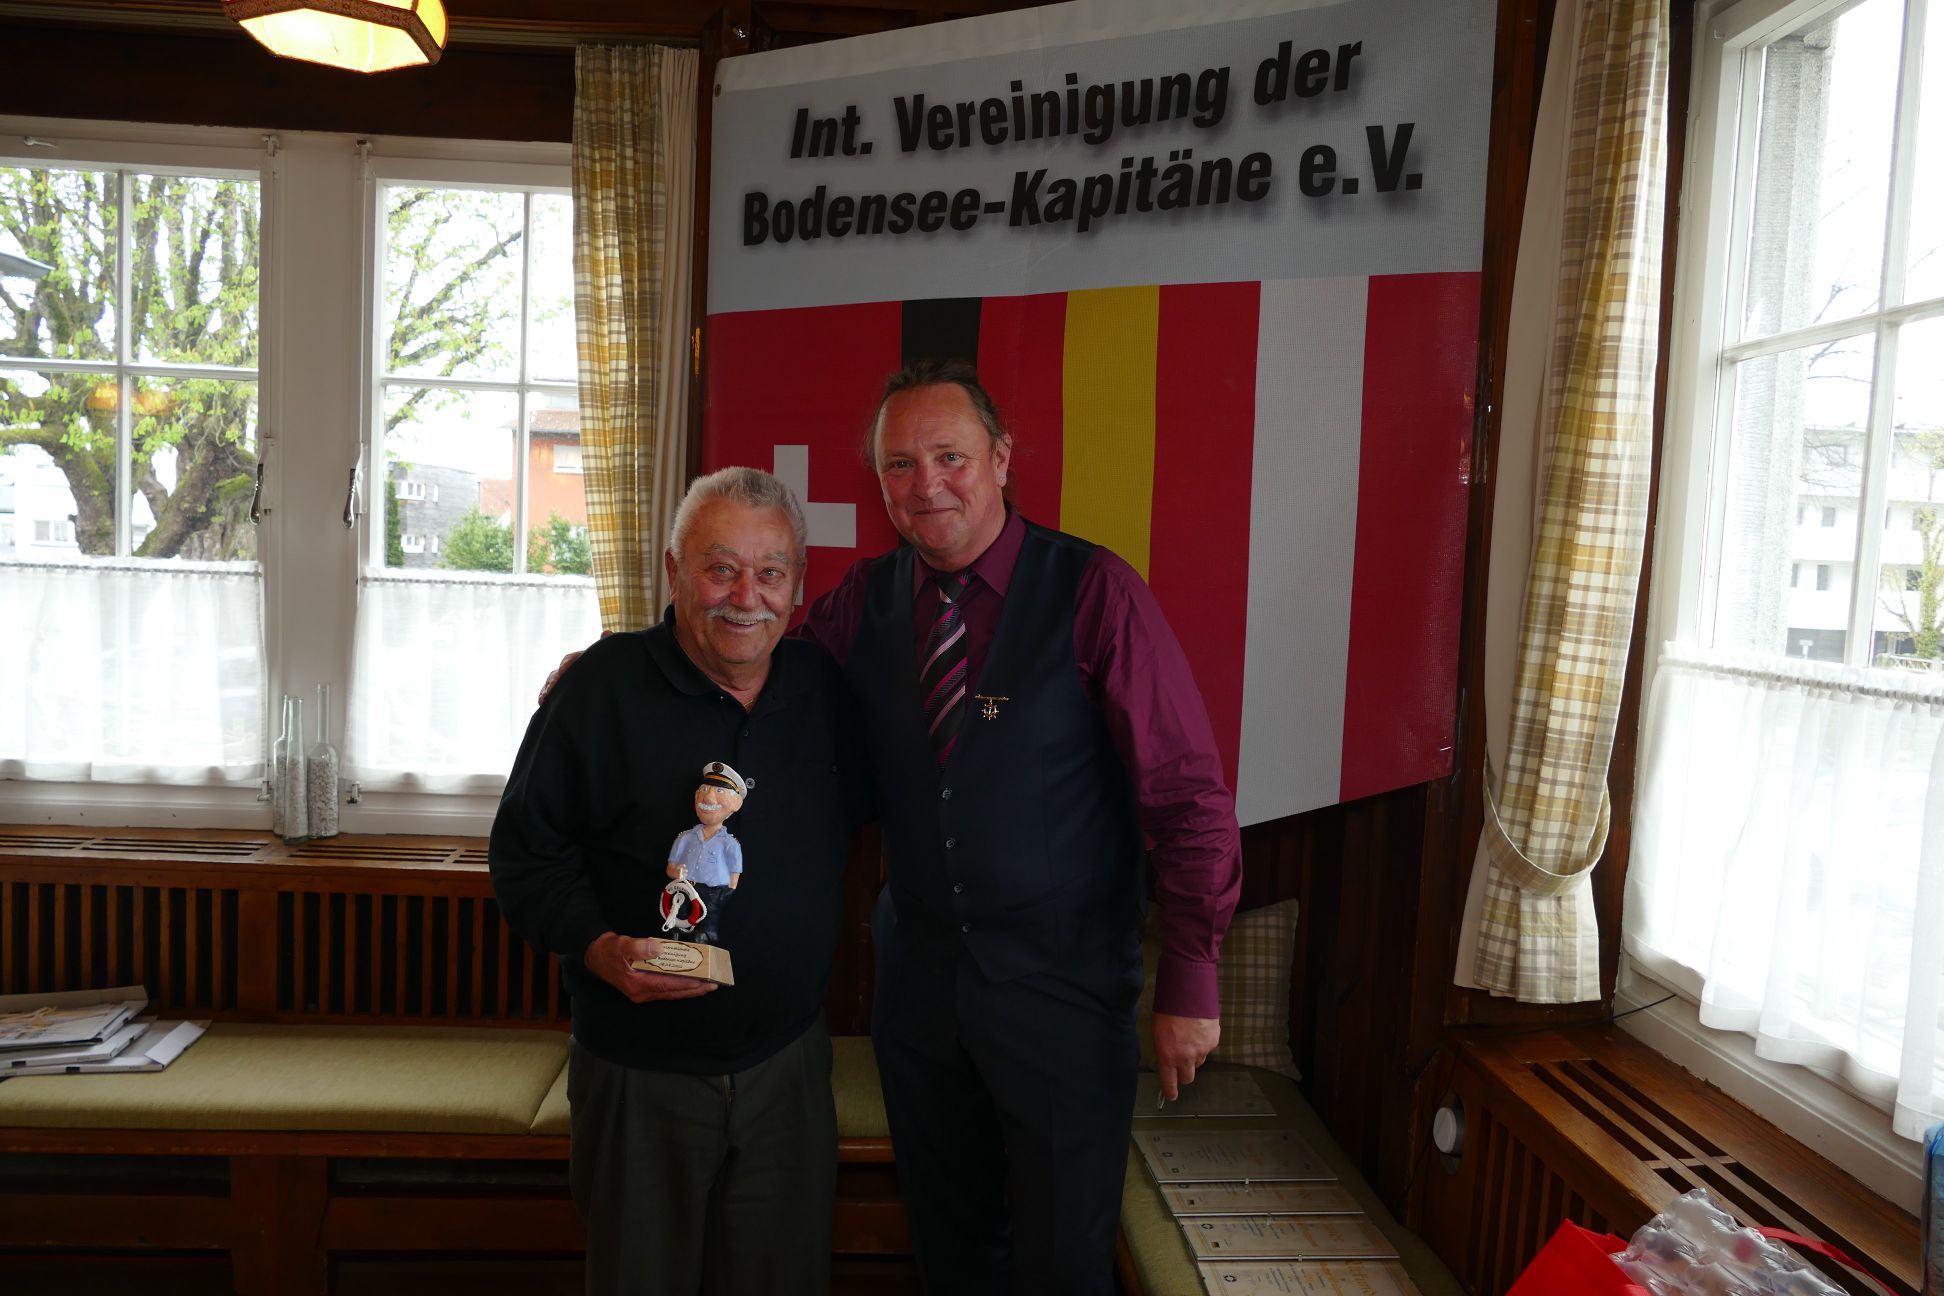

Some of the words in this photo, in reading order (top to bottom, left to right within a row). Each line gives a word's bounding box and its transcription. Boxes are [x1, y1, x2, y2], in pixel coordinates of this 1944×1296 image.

[790, 105, 873, 160] Int.
[893, 66, 1231, 153] Vereinigung
[1254, 40, 1363, 112] der
[743, 148, 1273, 247] Bodensee-Kapitäne
[1299, 122, 1423, 200] e.V.
